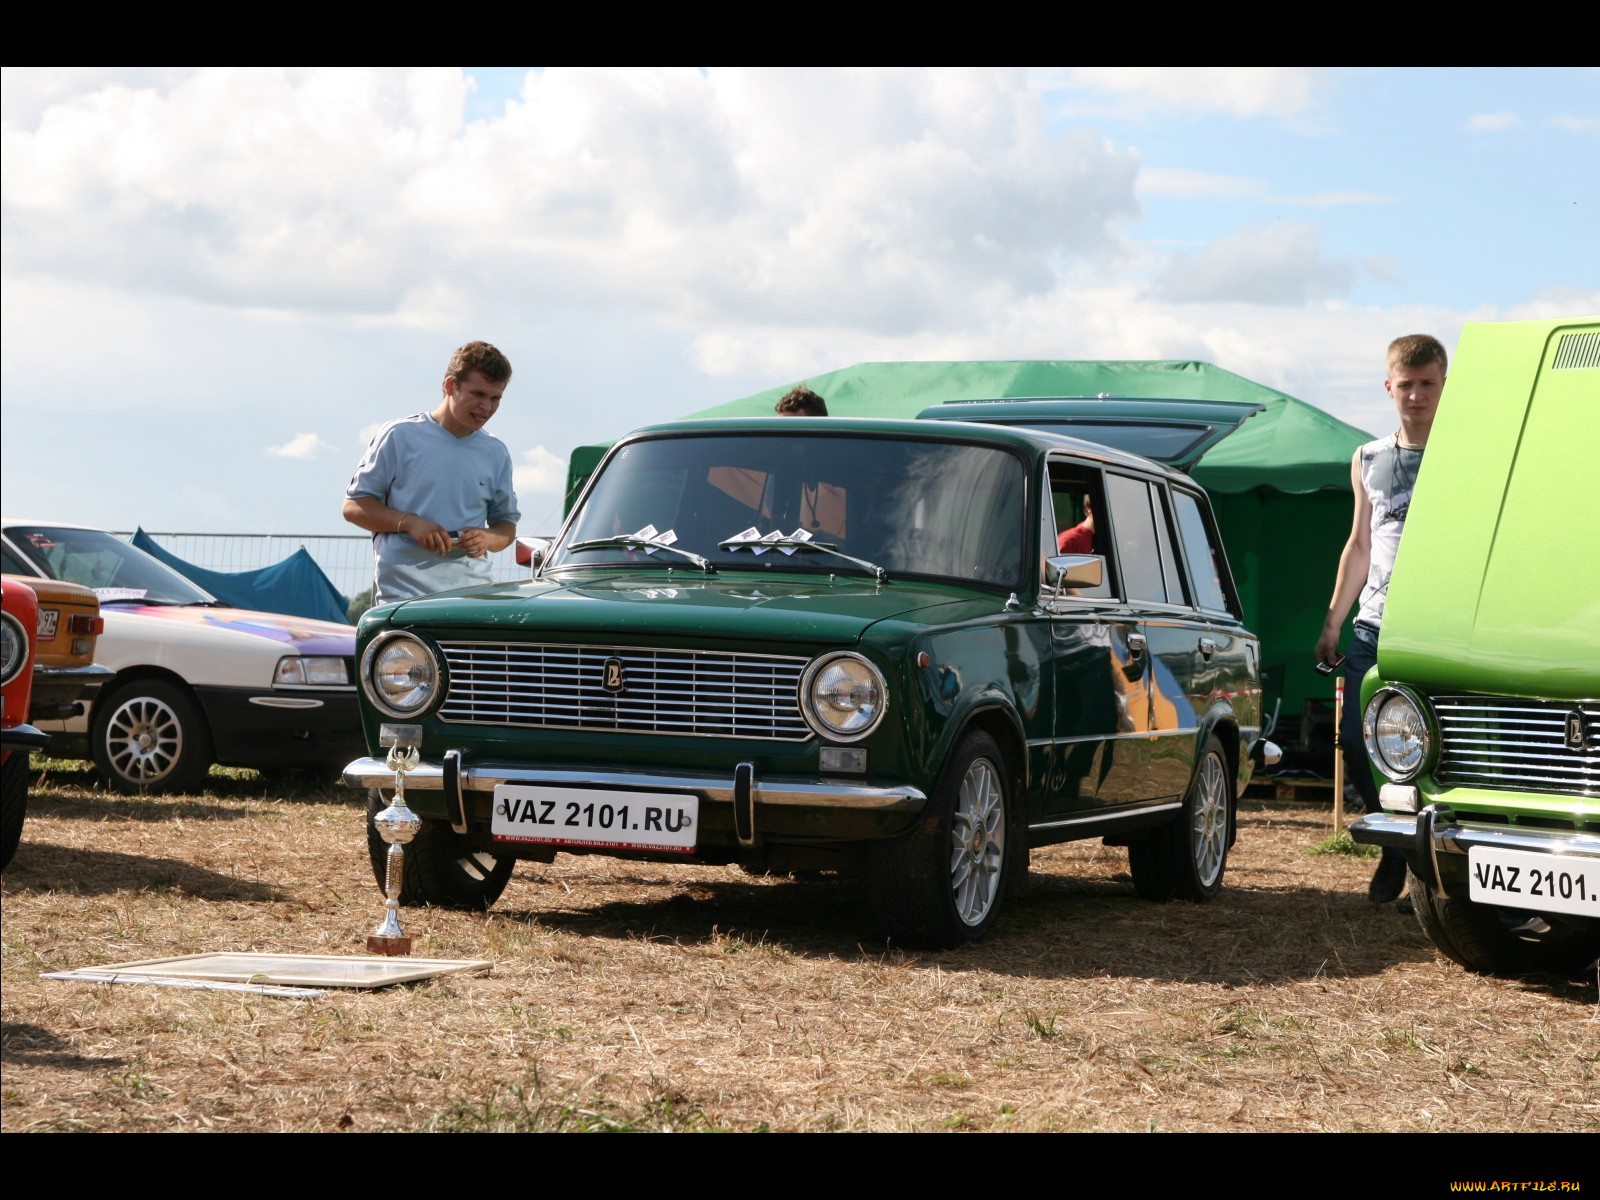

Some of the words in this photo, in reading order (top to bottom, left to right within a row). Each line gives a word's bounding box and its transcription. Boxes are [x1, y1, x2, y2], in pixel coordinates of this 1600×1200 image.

[503, 798, 556, 825] VAZ
[564, 801, 685, 832] 2101.RU
[1475, 862, 1522, 893] VAZ
[1530, 869, 1598, 901] 2101.
